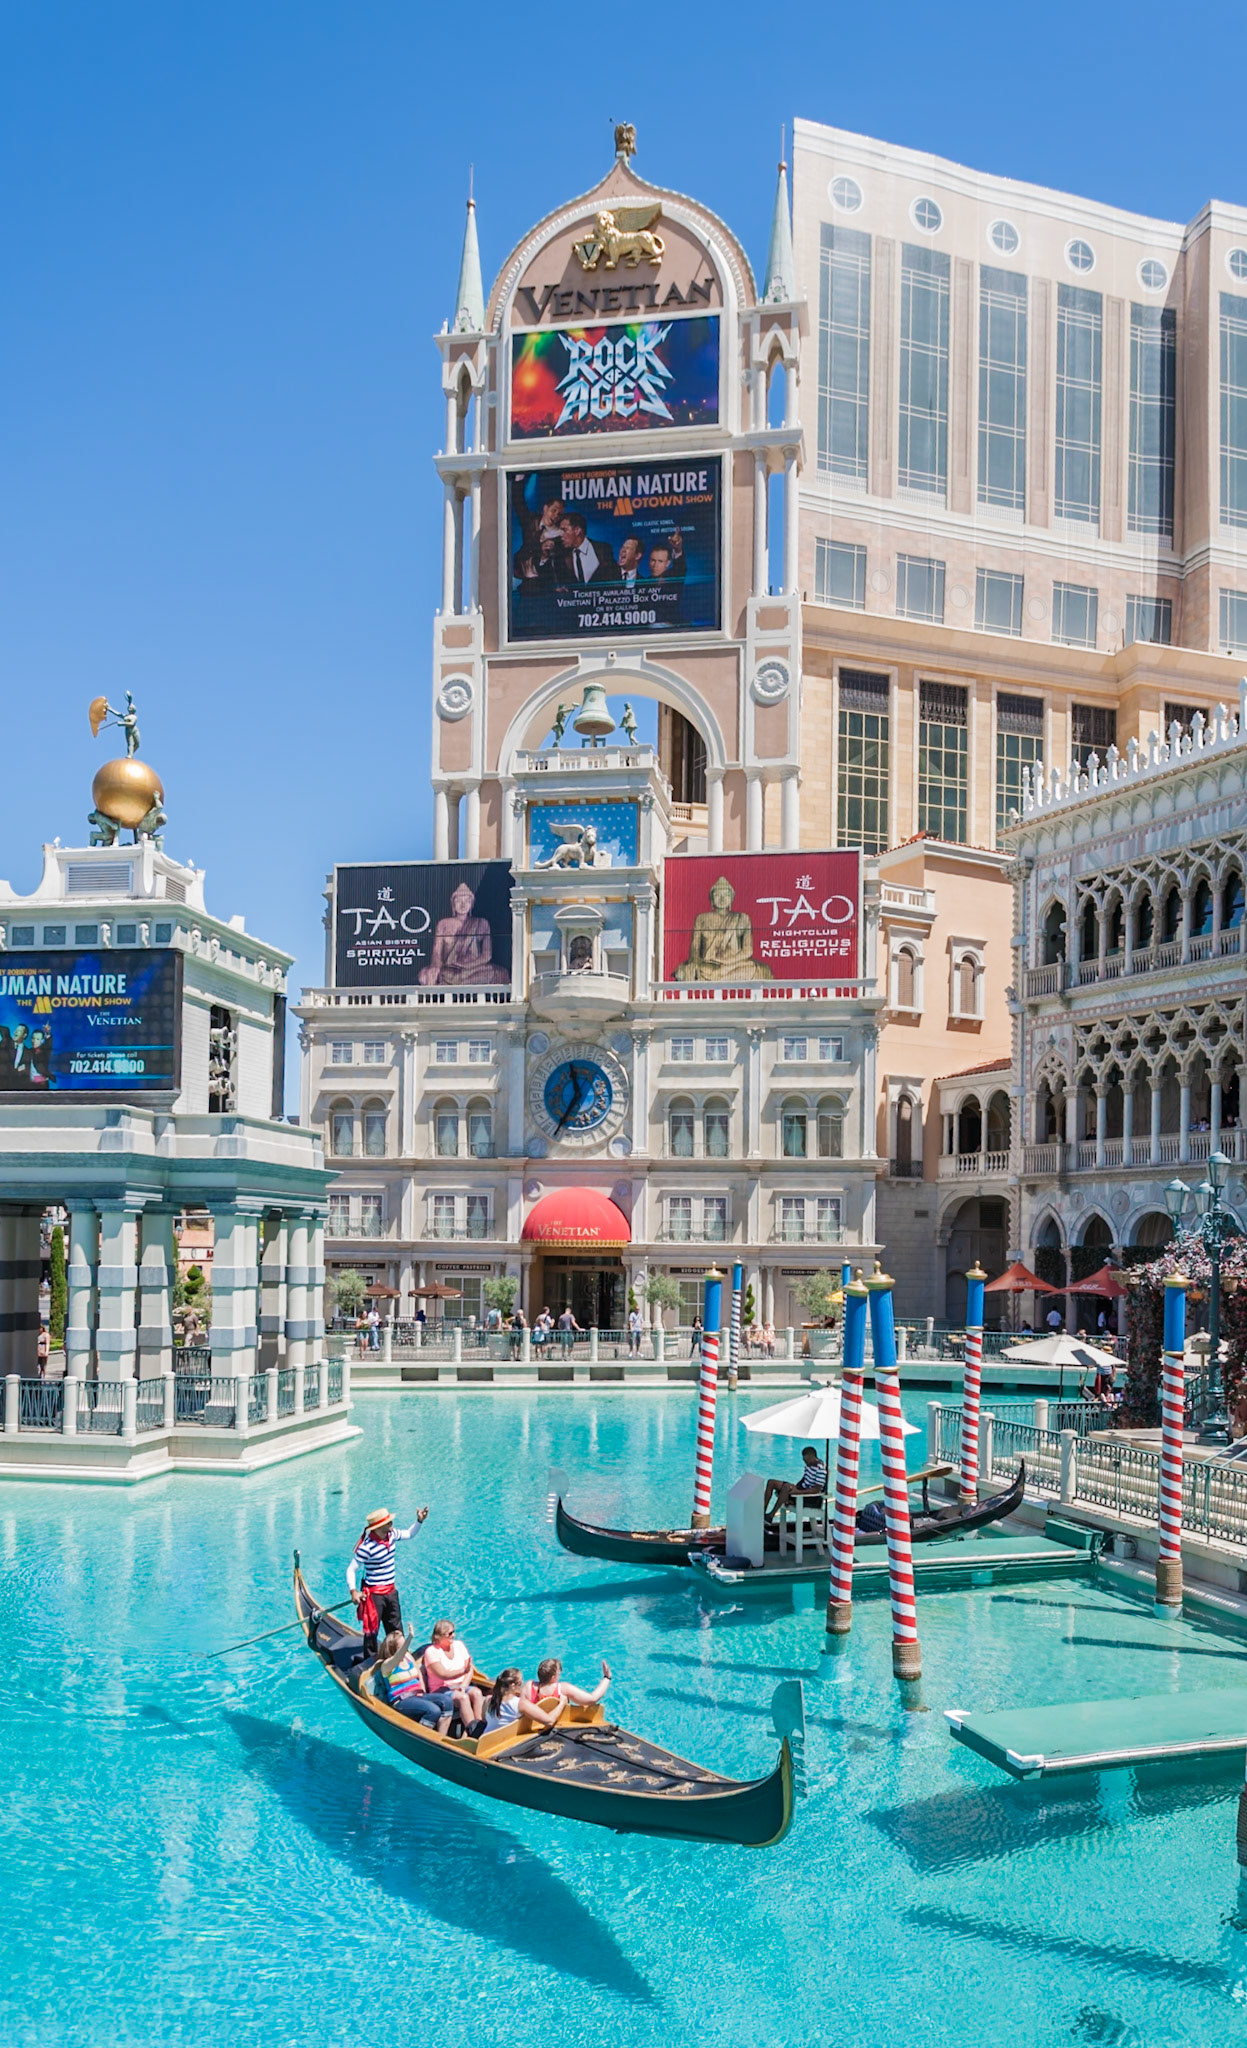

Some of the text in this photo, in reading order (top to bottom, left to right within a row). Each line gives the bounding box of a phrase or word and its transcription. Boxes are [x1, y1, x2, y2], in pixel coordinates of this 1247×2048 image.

[517, 278, 715, 323] VENETIAN
[554, 322, 675, 391] ROCK
[554, 374, 674, 430] AGES
[562, 472, 585, 480] SMOKEY
[586, 470, 616, 478] ROBINSON
[562, 471, 708, 500] HUMAN NATURE
[597, 494, 714, 516] THE MOTOWN SHOW
[578, 610, 656, 627] 702.414.9000
[795, 874, 816, 890] 道
[377, 886, 396, 902] 道
[756, 894, 854, 927] TAO
[340, 905, 431, 937] TAO
[385, 938, 418, 946] BISTRO
[760, 938, 851, 949] RELIGIOUS
[346, 948, 426, 958] SPIRITUAL
[762, 948, 849, 958] NIGHTLIFE
[358, 957, 413, 966] DINING
[56, 974, 126, 995] NATURE
[32, 996, 103, 1014] MOTOWN
[104, 998, 132, 1006] SHOW
[86, 1015, 142, 1026] VENETIAN
[538, 1224, 599, 1236] VENETIAN
